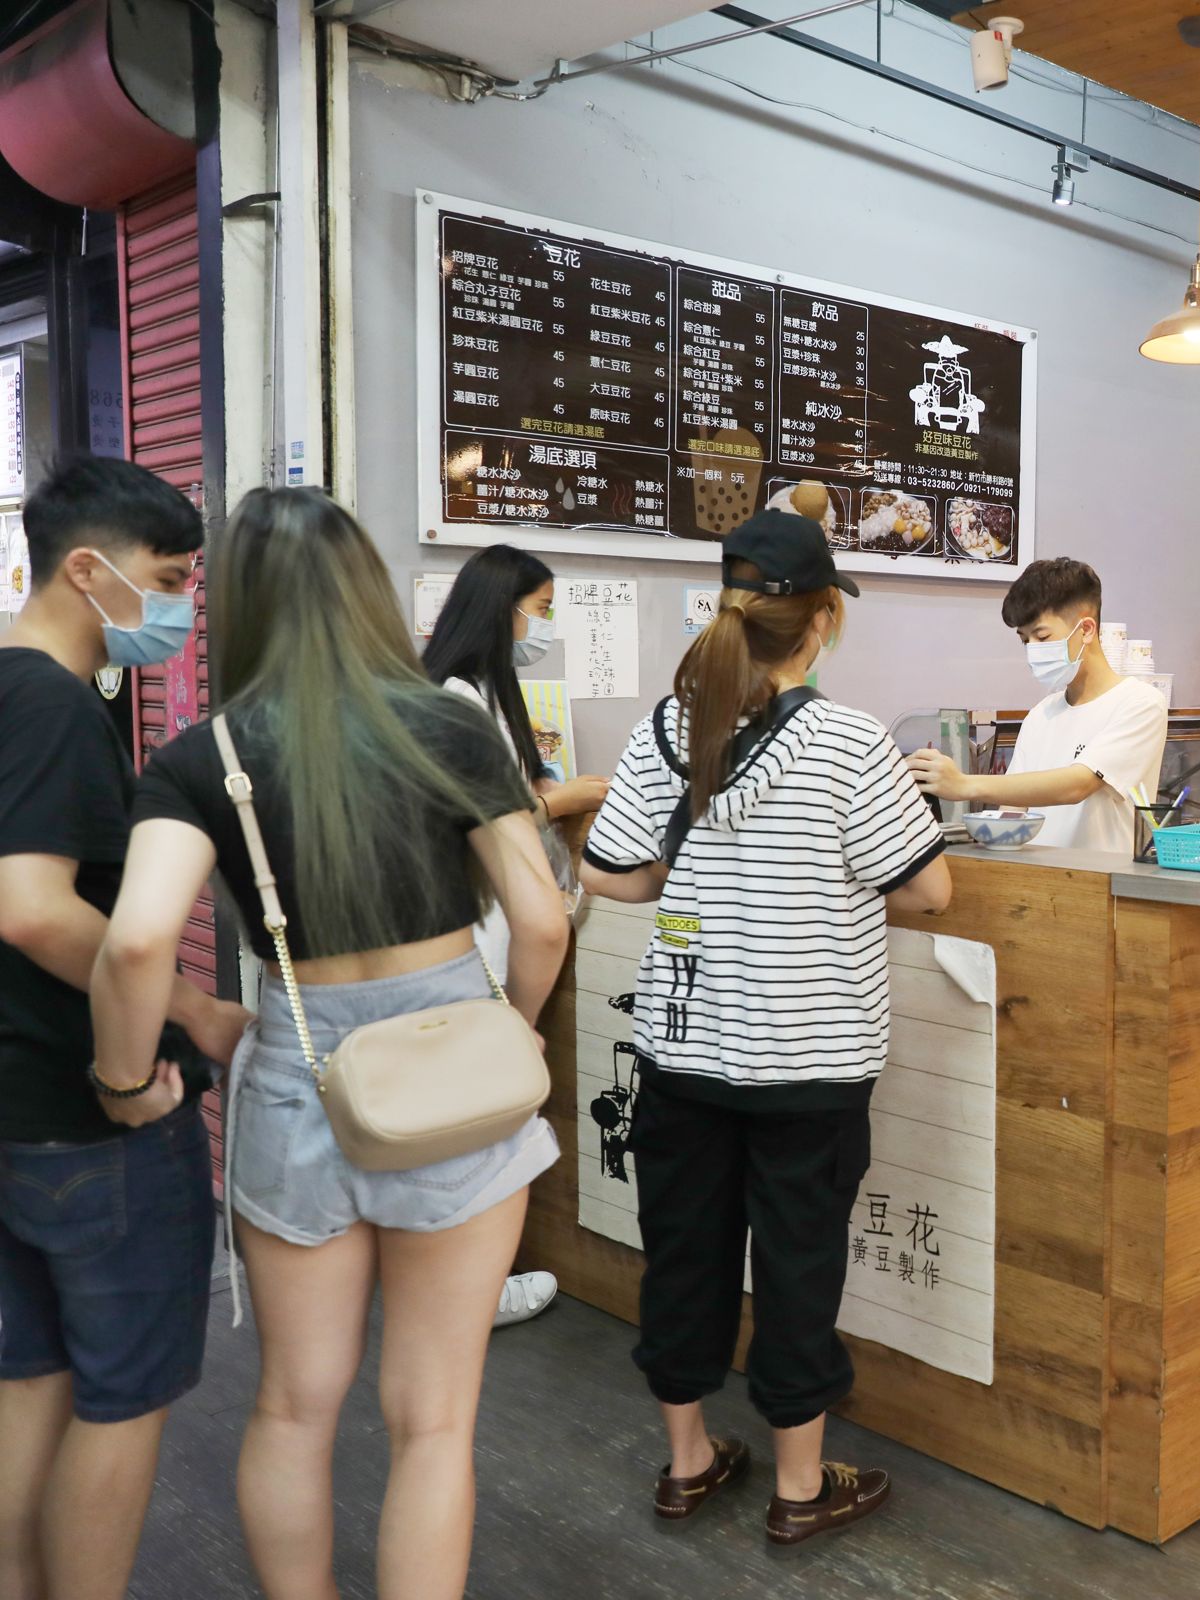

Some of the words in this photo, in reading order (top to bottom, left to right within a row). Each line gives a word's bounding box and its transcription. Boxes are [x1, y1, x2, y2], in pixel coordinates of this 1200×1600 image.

[452, 250, 499, 270] 招牌豆花
[552, 270, 565, 282] 55
[545, 245, 581, 269] 豆花
[452, 278, 521, 301] 綜合丸子豆花
[552, 297, 565, 308] 55
[590, 277, 632, 296] 花生豆花
[655, 291, 666, 302] 45
[711, 279, 741, 302] 甜品
[452, 306, 543, 332] 紅豆紫米湯圓豆花
[552, 323, 565, 335] 55
[590, 303, 651, 326] 紅豆紫米豆花
[655, 317, 666, 327] 45
[683, 297, 721, 316] 綜合甜湯
[755, 313, 766, 324] 55
[811, 301, 839, 322] 飲品
[683, 320, 721, 338] 綜合薏仁
[755, 335, 765, 346] 55
[783, 315, 817, 332] 無糖豆漿
[856, 331, 865, 341] 25
[452, 334, 499, 353] 珍珠豆花
[552, 350, 565, 362] 45
[590, 329, 631, 348] 綠豆豆花
[655, 341, 665, 352] 45
[783, 331, 837, 351] 豆漿+糖水冰沙
[855, 346, 865, 357] 30
[590, 355, 631, 373] 薏仁豆花
[654, 367, 665, 378] 45
[683, 343, 720, 360] 綜合紅豆
[755, 357, 765, 368] 55
[782, 347, 820, 364] 豆漿+珍珠
[855, 361, 865, 371] 30
[452, 362, 499, 380] 芋圓豆花
[552, 377, 565, 388] 45
[683, 366, 743, 387] 綜合紅豆+紫米
[754, 379, 765, 390] 55
[782, 363, 837, 381] 豆漿珍珠+冰沙
[855, 376, 865, 386] 35
[453, 389, 499, 408] 湯圓豆花
[552, 404, 565, 415] 45
[590, 382, 631, 399] 大豆豆花
[654, 392, 665, 403] 45
[682, 389, 720, 406] 綜合綠豆
[754, 401, 765, 411] 55
[590, 408, 631, 425] 原味豆花
[653, 417, 664, 428] 45
[805, 400, 842, 420] 純冰沙
[520, 416, 605, 439] 選完豆花請選湯底
[682, 412, 738, 430] 紅豆紫米湯圓
[754, 423, 764, 433] 55
[781, 418, 816, 433] 糖水冰沙
[854, 429, 864, 439] 40
[922, 429, 972, 449] 好豆味豆花
[528, 444, 597, 470] 湯底選項
[781, 449, 815, 463] 豆漿冰沙
[476, 465, 521, 481] 糖水冰沙
[577, 475, 608, 490] 冷糖水
[730, 472, 745, 484] 5元
[634, 479, 664, 494] 熱糖水
[477, 502, 550, 519] 豆漿/糖水冰沙
[577, 492, 598, 506] 豆漿
[568, 583, 634, 605] 招牌豆花
[863, 1192, 940, 1256] 豆花
[851, 1235, 940, 1291] 黃豆製作
